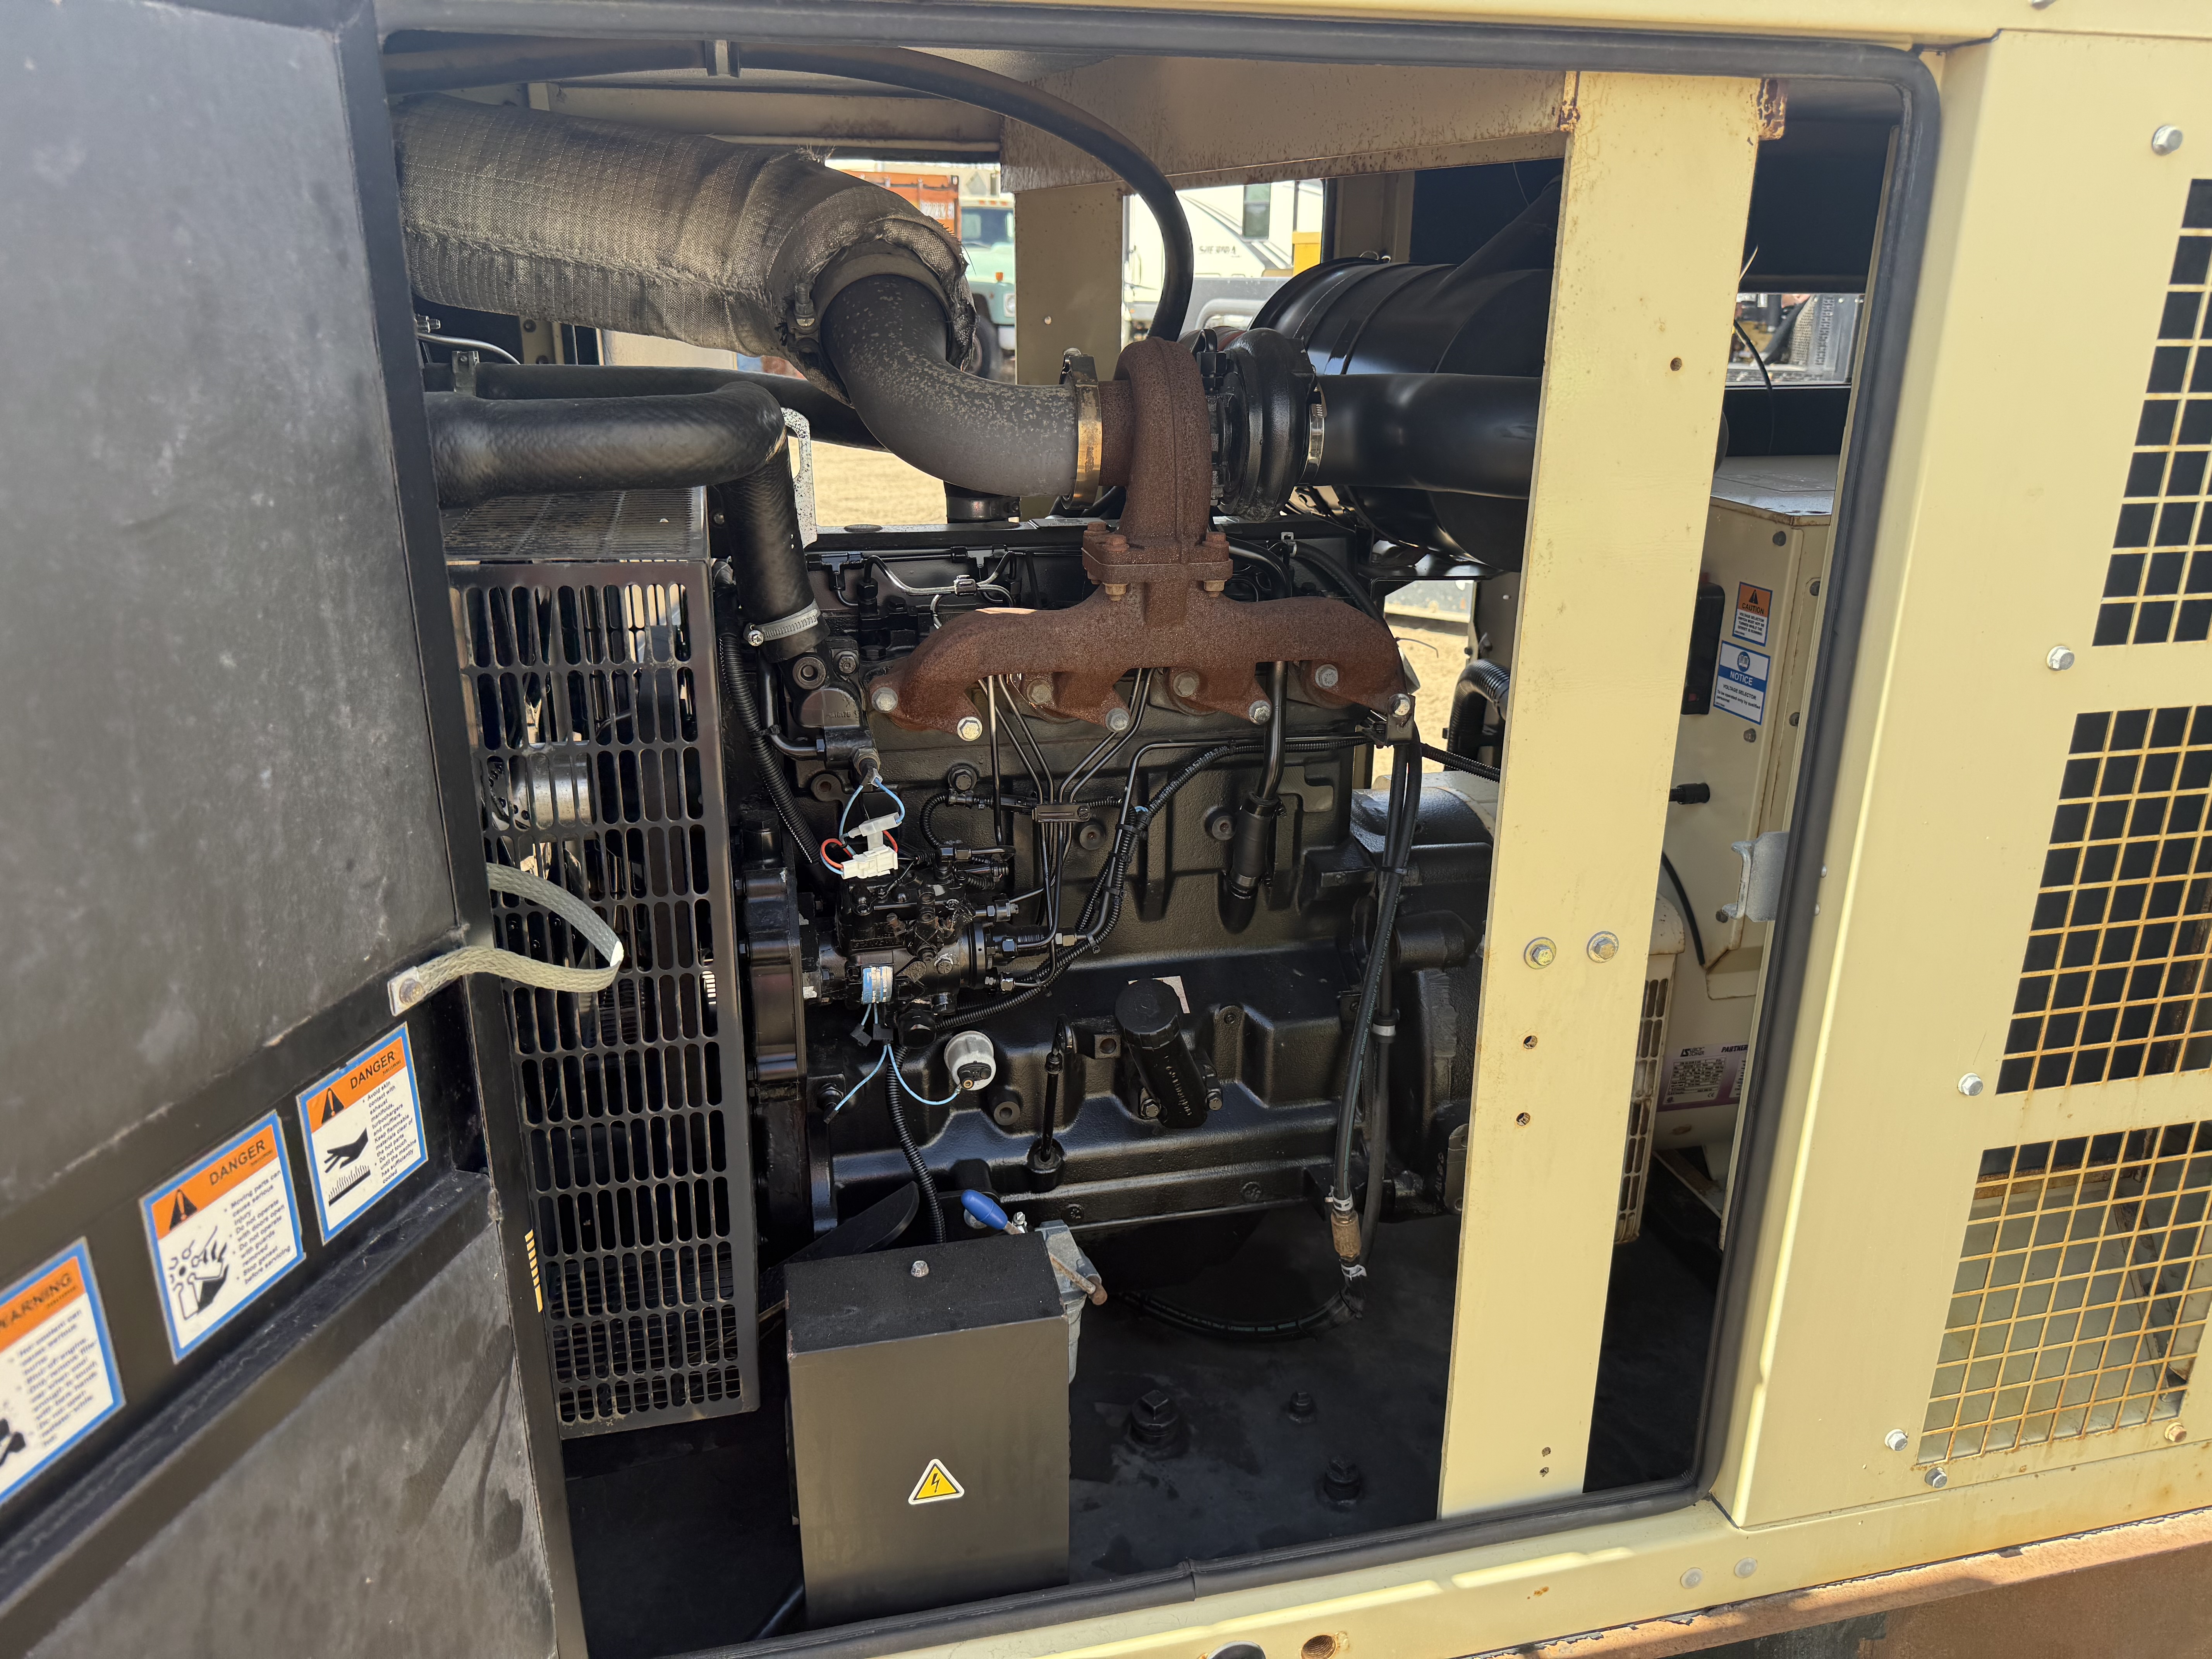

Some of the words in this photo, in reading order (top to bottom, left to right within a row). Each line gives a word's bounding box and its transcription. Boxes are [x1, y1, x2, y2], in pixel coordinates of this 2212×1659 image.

[1742, 603, 1764, 615] CAUTION
[1723, 684, 1738, 693] VOLTAGE
[1738, 690, 1756, 700] SELECTOR
[1730, 671, 1753, 686] NOTICE
[350, 1051, 395, 1090] DANGER
[368, 1087, 380, 1101] Avoid
[381, 1081, 391, 1091] skin
[369, 1092, 385, 1108] contact
[386, 1085, 395, 1095] with
[370, 1098, 388, 1115] exhaust
[371, 1103, 394, 1122] manifolds,
[372, 1103, 403, 1129] turbochargers
[373, 1126, 382, 1137] and
[383, 1113, 402, 1129] mufflers.
[374, 1132, 386, 1144] Keep
[387, 1114, 409, 1134] flammable
[376, 1132, 396, 1151] materials
[397, 1123, 407, 1134] clear
[393, 1133, 404, 1146] parts
[394, 1139, 407, 1151] touch
[209, 1139, 265, 1186] DANGER
[380, 1159, 390, 1170] until
[398, 1139, 417, 1156] machine
[381, 1168, 390, 1177] has
[390, 1149, 414, 1170] sufficiently
[230, 1190, 253, 1209] Moving
[254, 1179, 269, 1194] parts
[270, 1170, 281, 1180] can
[383, 1169, 397, 1184] cooled
[232, 1202, 250, 1217] cause
[252, 1185, 274, 1203] serious
[234, 1210, 251, 1226] injury
[236, 1225, 244, 1235] Do
[246, 1216, 256, 1227] not
[257, 1199, 279, 1218] operate
[237, 1230, 251, 1242] with
[252, 1216, 269, 1231] doors
[270, 1204, 285, 1218] open
[239, 1242, 247, 1251] Do
[249, 1232, 259, 1243] not
[261, 1216, 282, 1235] operate
[240, 1247, 254, 1259] with
[255, 1230, 275, 1250] guards
[242, 1243, 268, 1267] removed
[243, 1263, 257, 1276] Stop
[258, 1245, 278, 1266] genset
[244, 1267, 263, 1285] before
[264, 1245, 291, 1269] servicing
